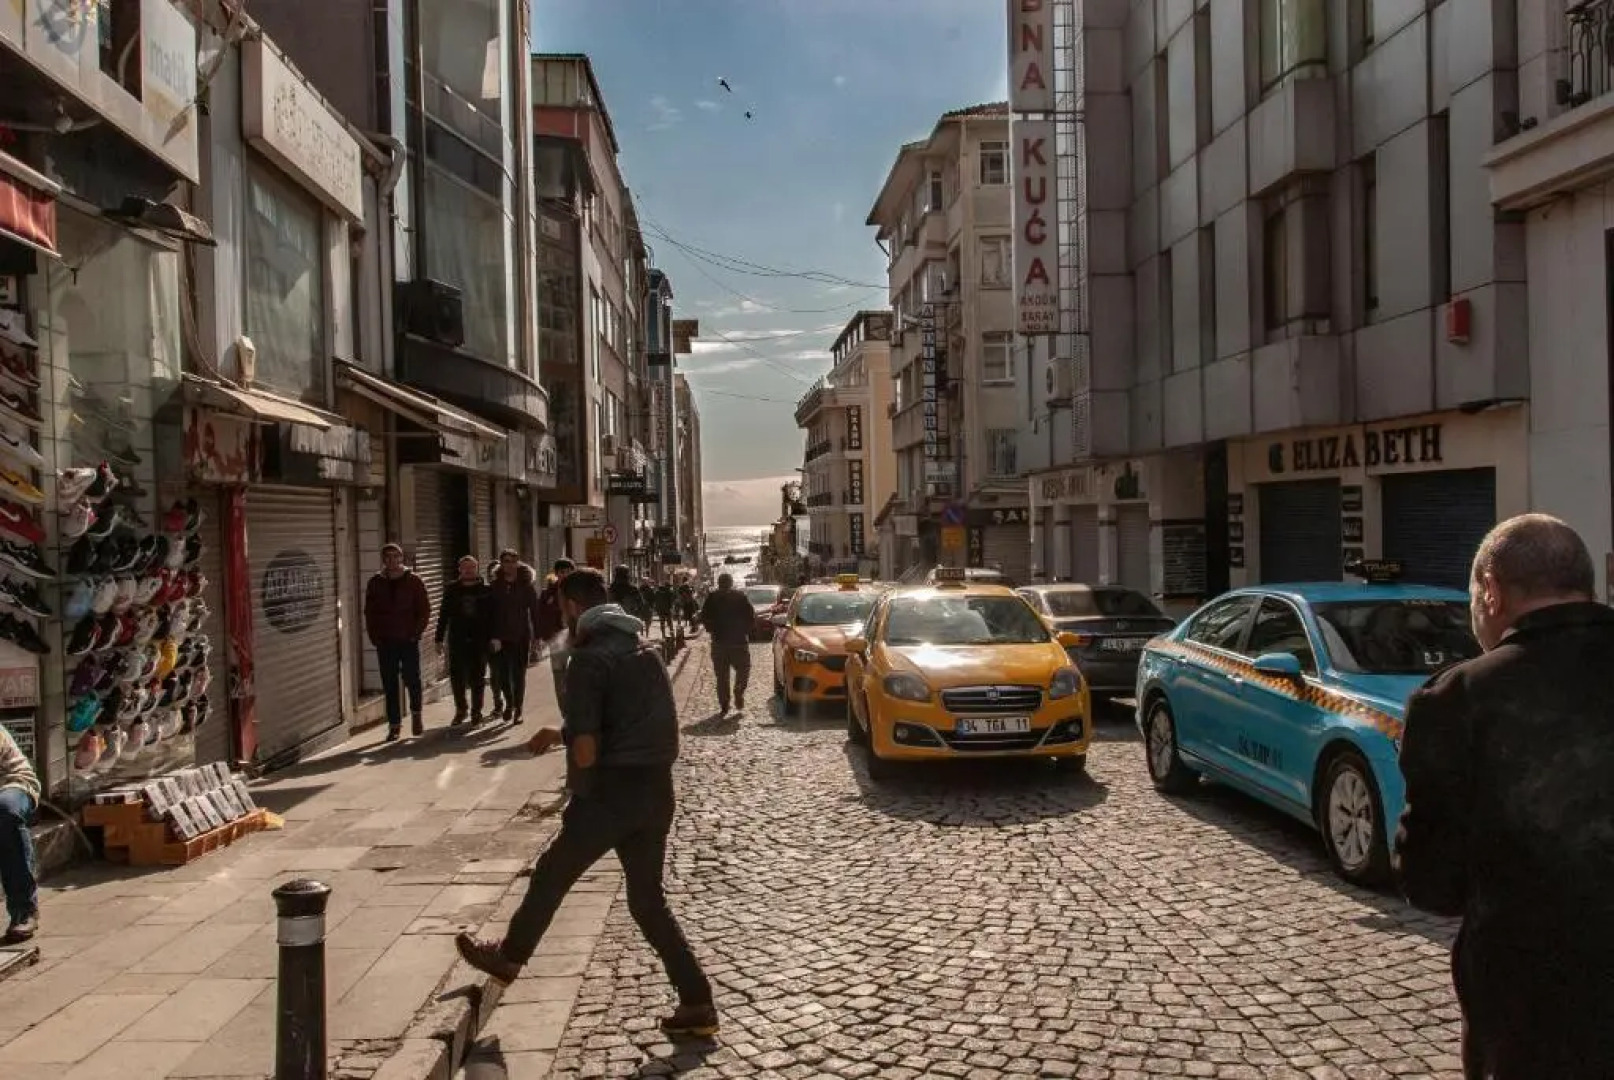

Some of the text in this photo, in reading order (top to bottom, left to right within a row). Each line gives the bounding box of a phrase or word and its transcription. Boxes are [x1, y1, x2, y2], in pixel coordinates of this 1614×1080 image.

[1022, 138, 1049, 285] KUĆA
[1292, 424, 1443, 472] ELIZABETH
[964, 718, 1027, 732] 34 TGA 11
